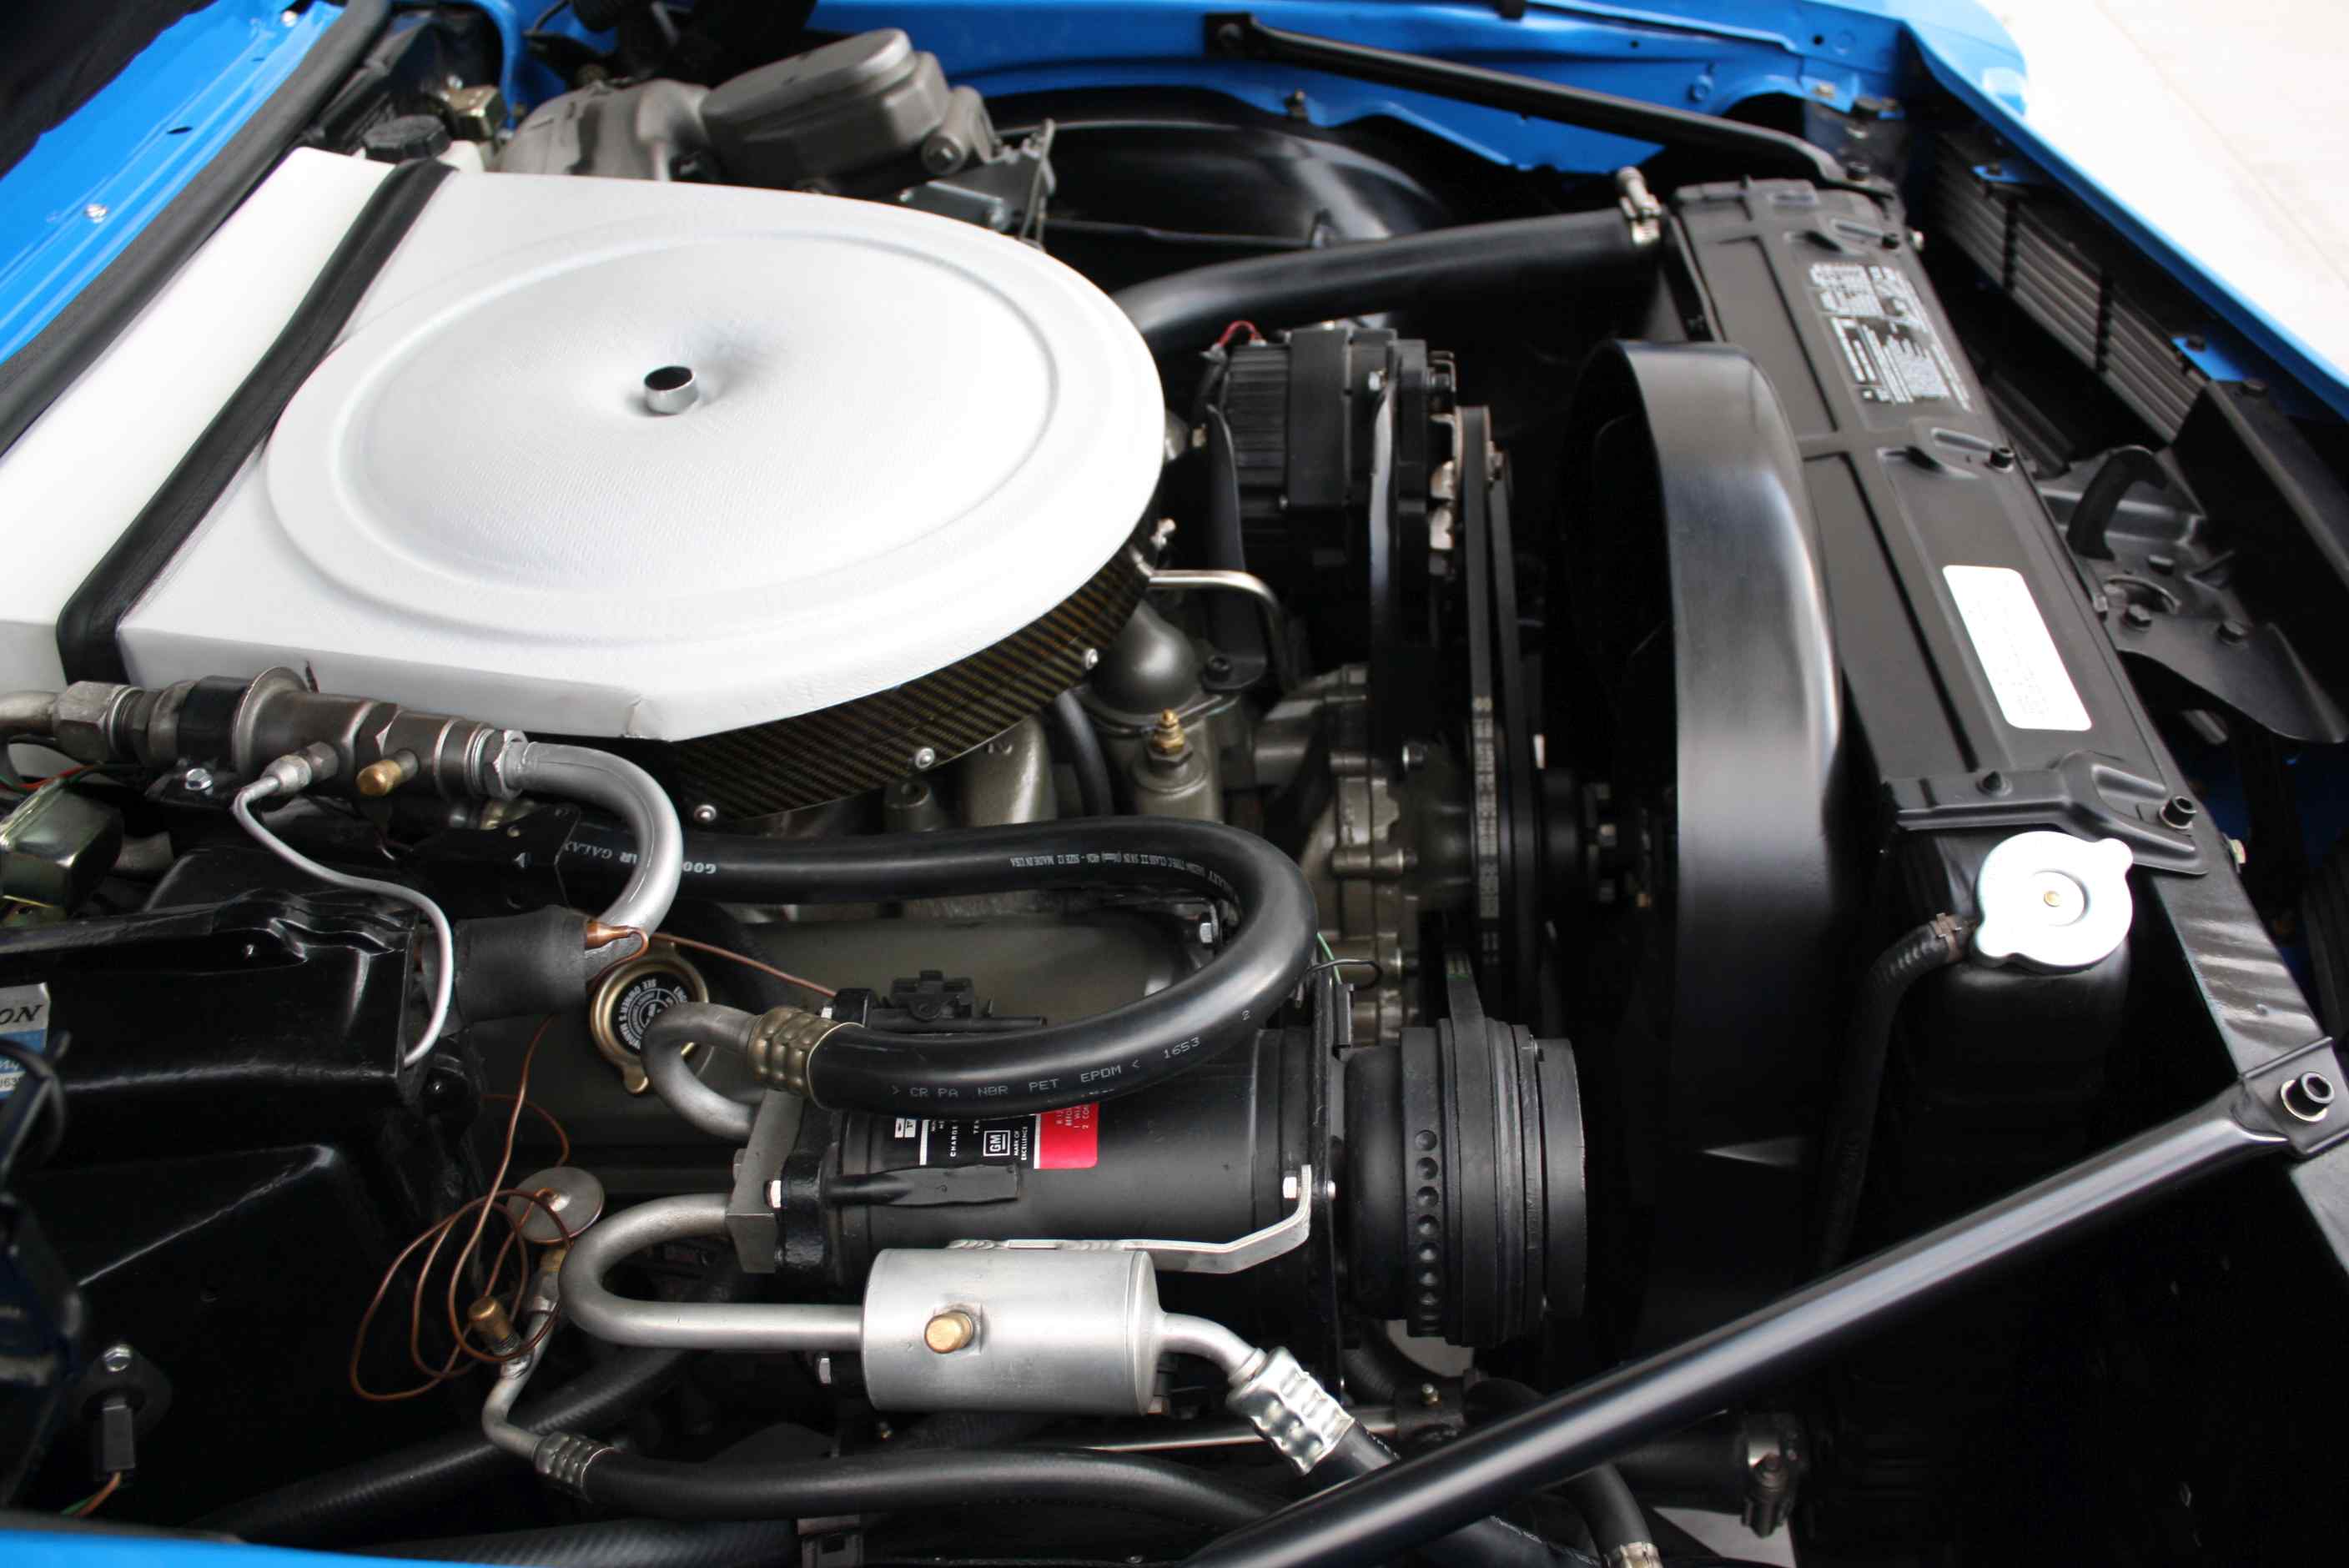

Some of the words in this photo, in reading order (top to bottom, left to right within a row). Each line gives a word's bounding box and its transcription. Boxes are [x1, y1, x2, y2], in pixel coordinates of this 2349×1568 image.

[1010, 857, 1025, 867] USA
[1025, 856, 1034, 867] IN
[1034, 856, 1055, 867] MADE
[909, 1087, 928, 1097] CR
[938, 1088, 958, 1098] PA
[978, 1085, 1009, 1097] NBR
[1029, 1078, 1059, 1092] PET
[1080, 1065, 1122, 1083] EPDM
[1164, 1037, 1200, 1059] 1653
[1014, 1130, 1019, 1138] OF
[949, 1125, 958, 1158] CHARGE
[989, 1134, 1001, 1152] GM
